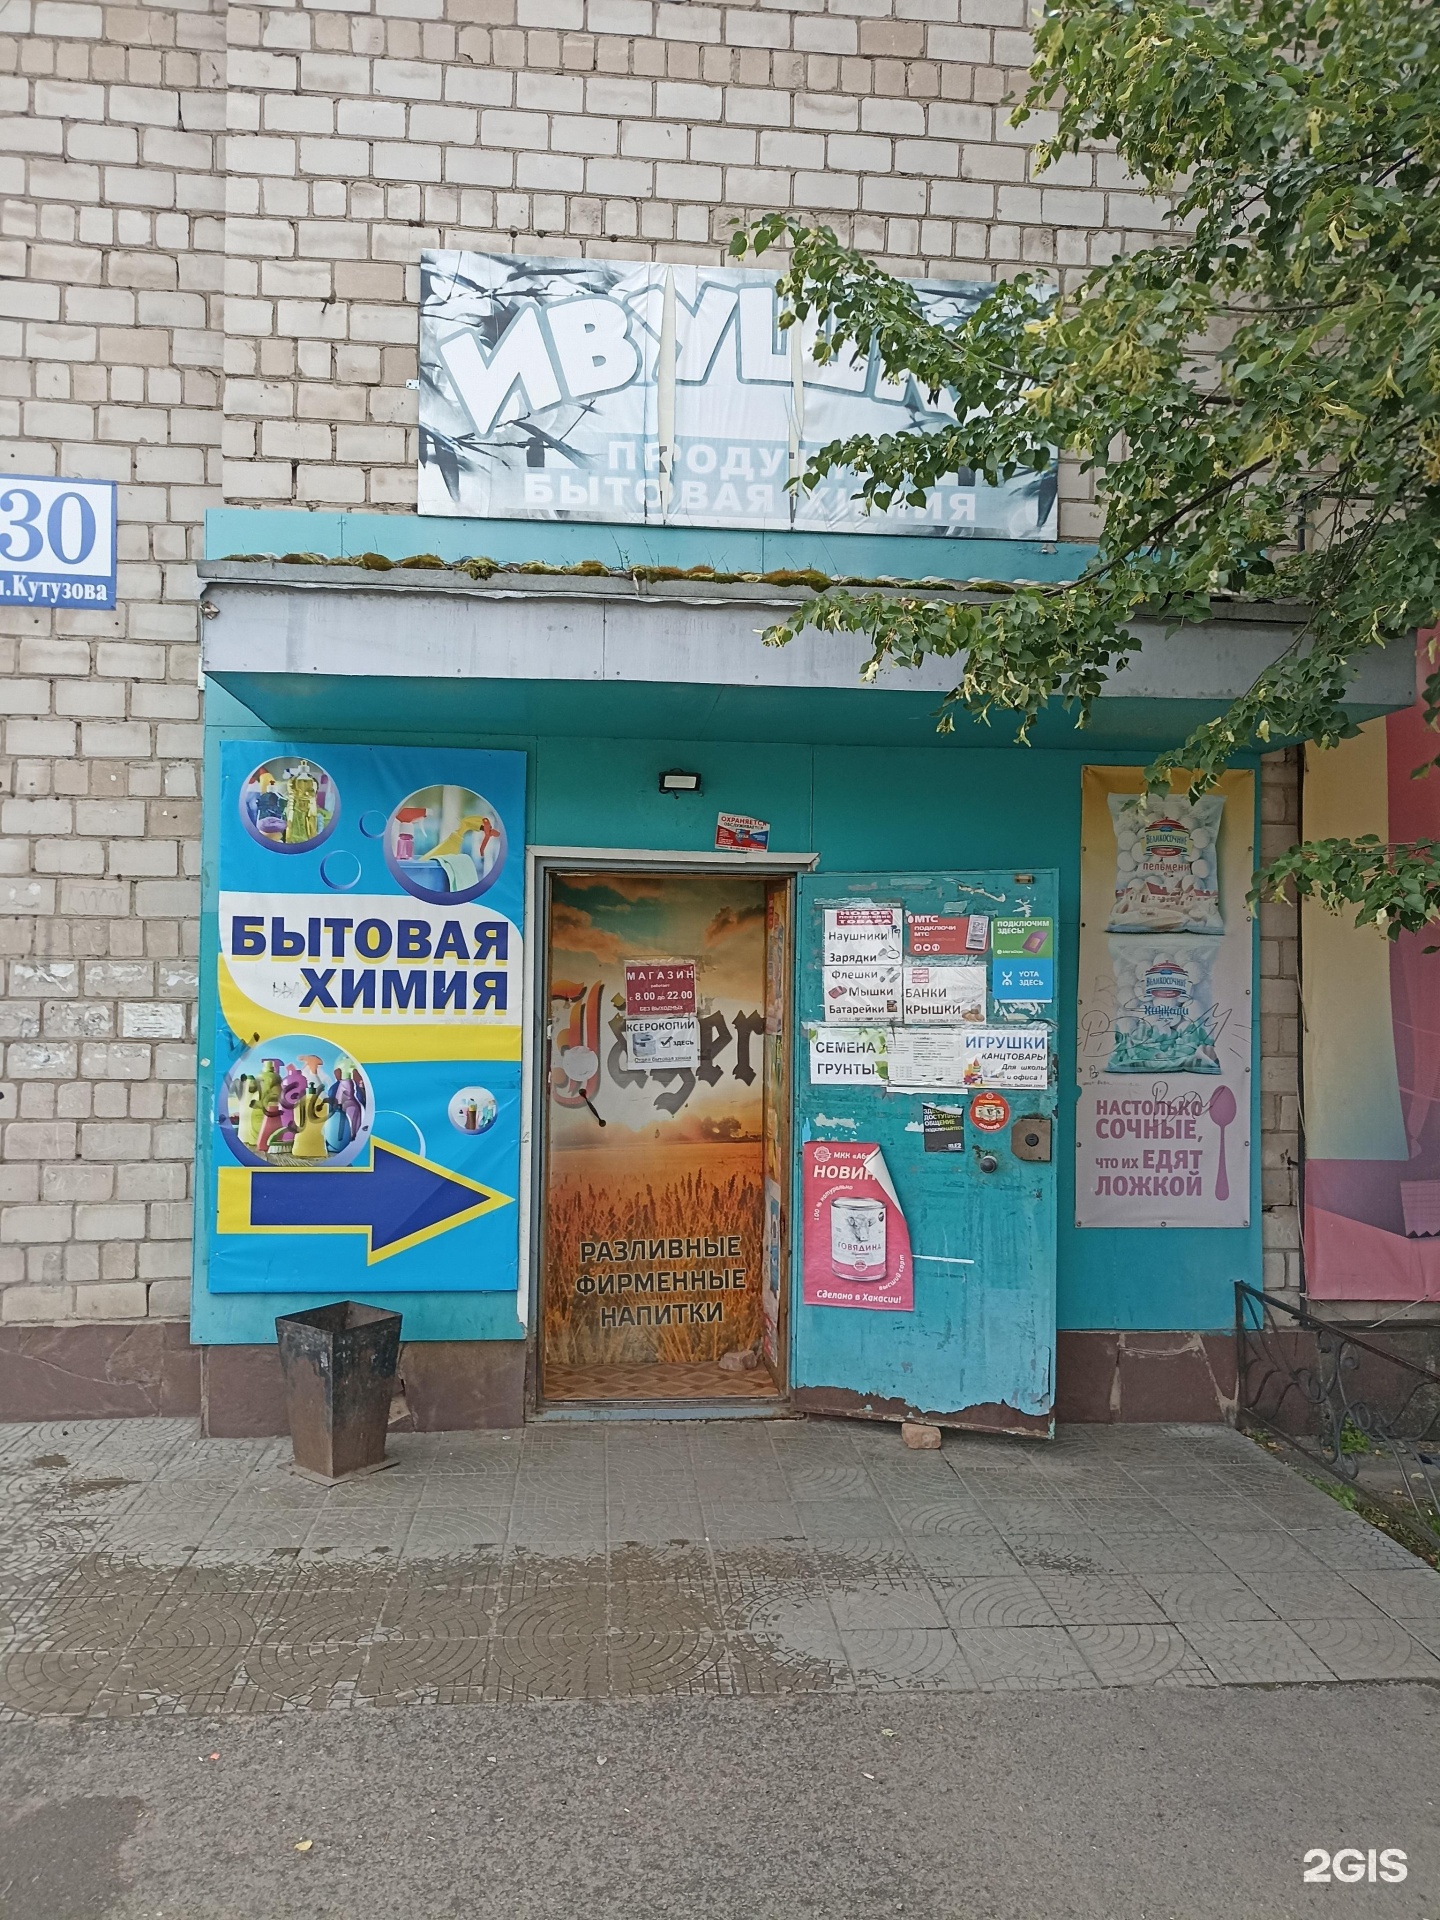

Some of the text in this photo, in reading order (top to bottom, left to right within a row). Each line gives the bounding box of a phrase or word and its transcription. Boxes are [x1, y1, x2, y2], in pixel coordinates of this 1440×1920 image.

[440, 284, 1010, 434] ИВУШ
[523, 473, 774, 512] БЫТОВАЯ
[0, 488, 97, 565] 30
[1142, 862, 1190, 873] пельмени
[914, 915, 939, 923] МТС
[232, 916, 509, 962] БЫТОВАЯ
[828, 931, 888, 942] Наушники
[829, 952, 877, 964] Зарядки
[627, 971, 694, 981] МАГАЗИН
[831, 970, 878, 979] Флешки
[299, 967, 509, 1012] ХИМИЯ
[849, 987, 894, 996] Мышки
[905, 988, 947, 998] БАНКИ
[635, 992, 655, 1001] 8.00
[667, 991, 693, 1000] 22.00
[829, 1004, 885, 1015] Батарейки
[905, 1004, 961, 1015] КРЫШКИ
[815, 1041, 876, 1053] СЕМЕНА
[965, 1036, 1045, 1050] ИГРУШКИ
[981, 1052, 1047, 1061] КАНЦТОВАРЫ
[817, 1063, 875, 1075] ГРУНТЫ
[1001, 1063, 1017, 1071] Для
[1096, 1100, 1203, 1117] НАСТОЛЬКО
[1095, 1118, 1203, 1143] СОЧНЫЕ,
[1095, 1149, 1203, 1174] ЧТО ИХ ЕДЯТ
[1094, 1170, 1203, 1197] ЛОЖКОЙ
[580, 1236, 742, 1263] РАЗЛИВНЫЕ
[838, 1241, 882, 1252] ГОВЯДИНА
[575, 1268, 747, 1297] ФИРМЕННЫЕ
[878, 1272, 902, 1291] высший
[816, 1290, 853, 1300] Сделано
[862, 1293, 902, 1304] Хакасии!
[600, 1302, 724, 1328] НАПИТКИ
